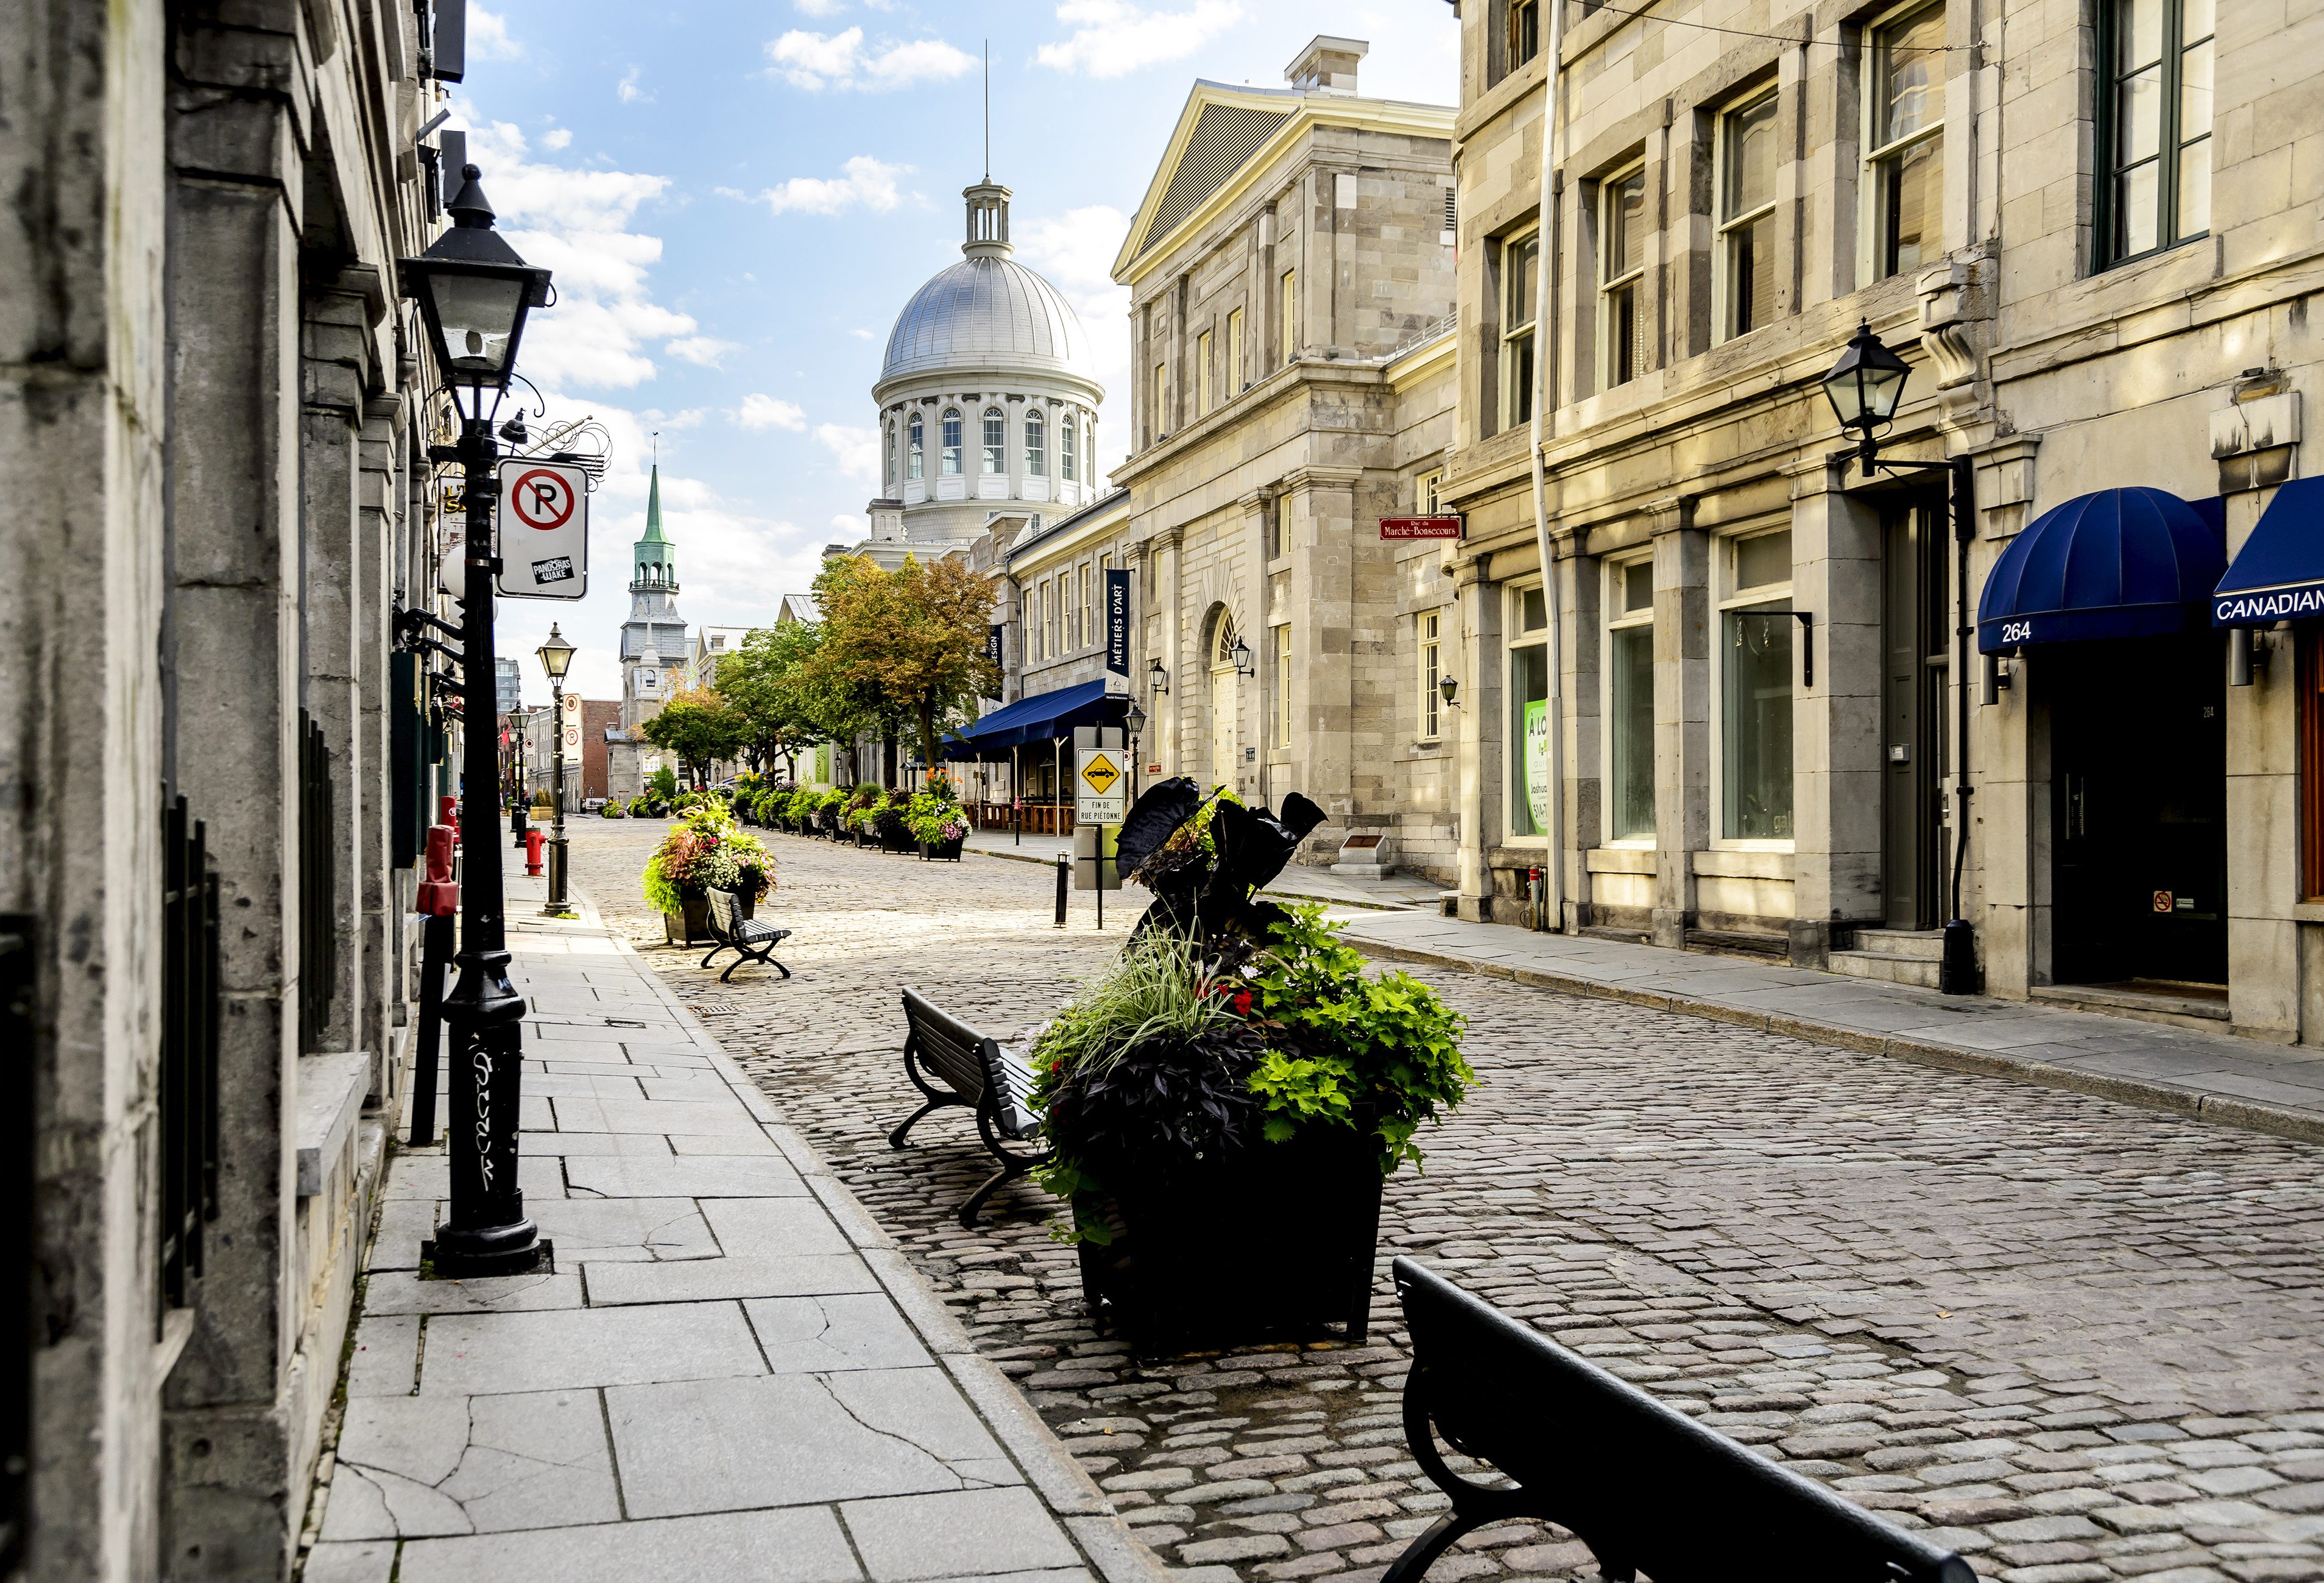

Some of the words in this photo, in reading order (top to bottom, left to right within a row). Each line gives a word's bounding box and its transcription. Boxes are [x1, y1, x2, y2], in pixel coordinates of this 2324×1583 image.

[1384, 525, 1457, 536] Marché-Bonsecours
[541, 569, 567, 581] WAKE
[2002, 621, 2032, 643] 264
[1112, 618, 1122, 665] MÉTIERS
[2203, 706, 2214, 718] 264
[1528, 712, 1535, 737] À
